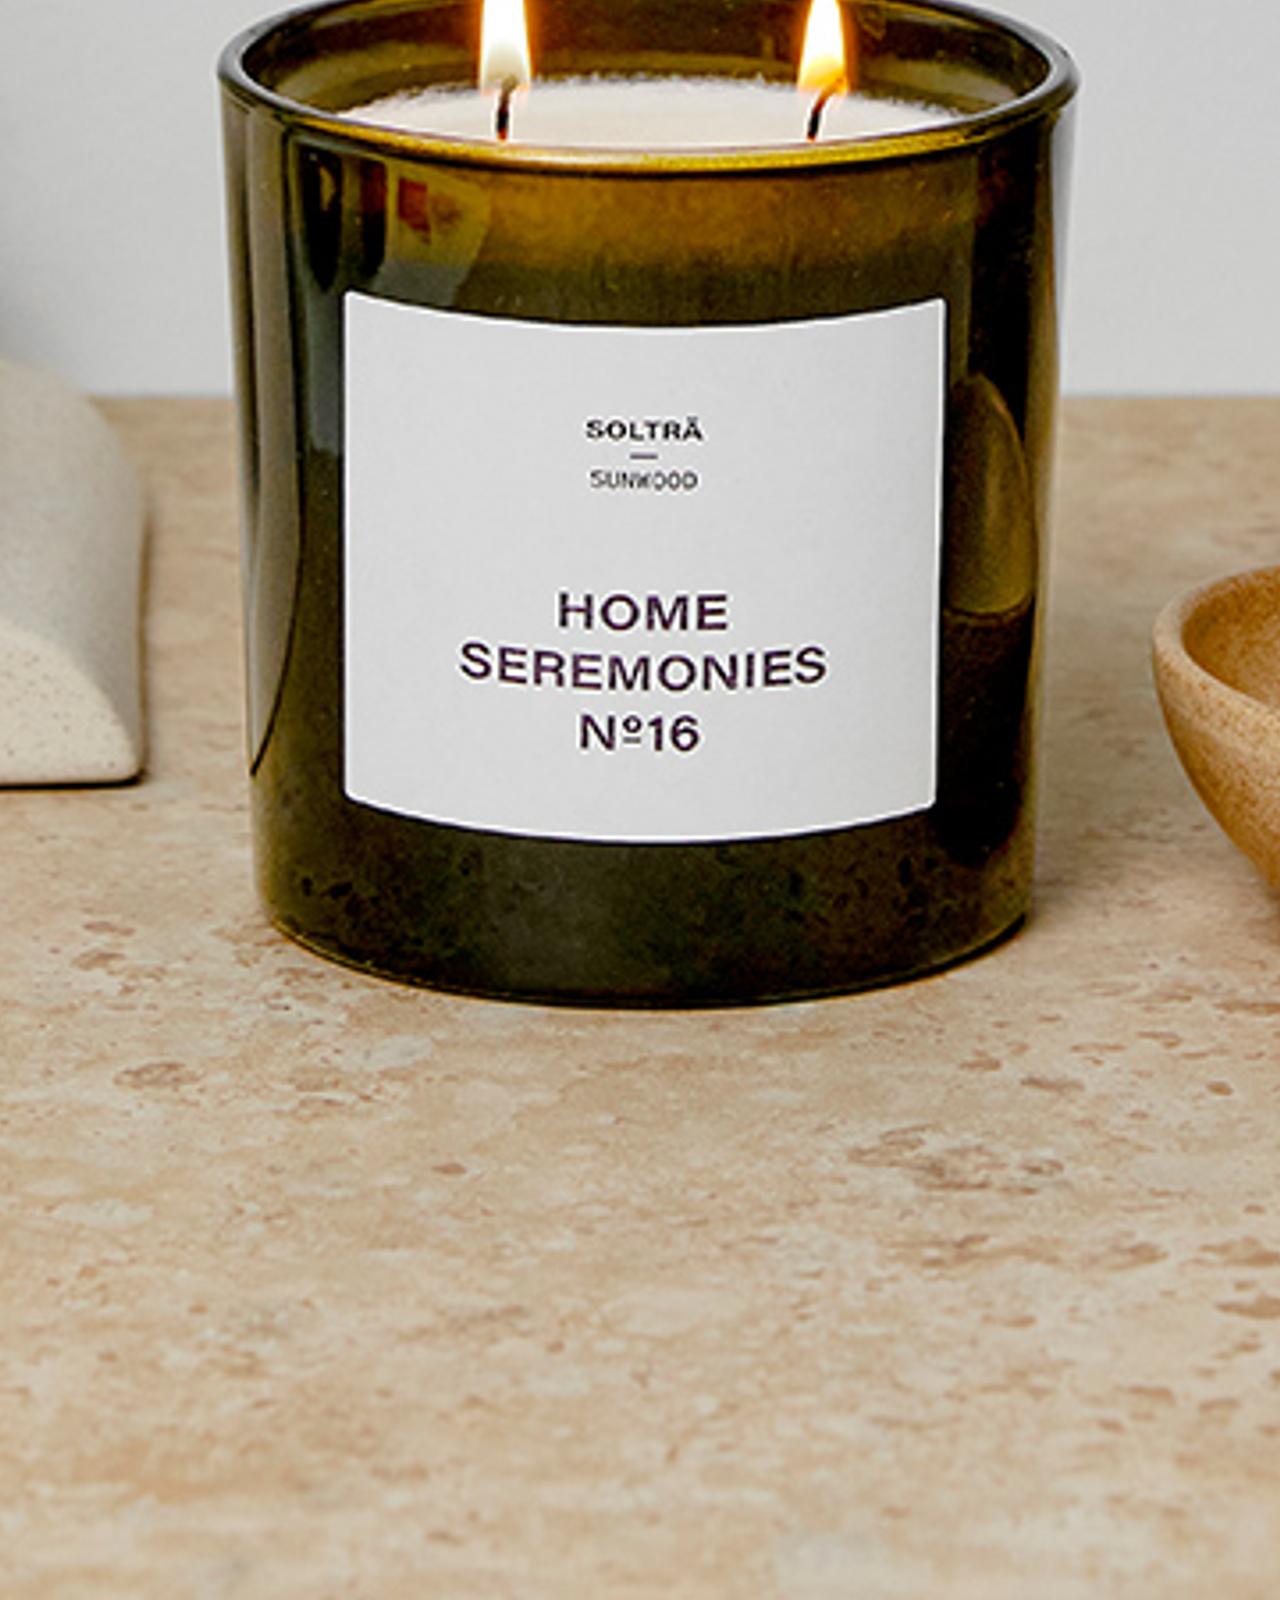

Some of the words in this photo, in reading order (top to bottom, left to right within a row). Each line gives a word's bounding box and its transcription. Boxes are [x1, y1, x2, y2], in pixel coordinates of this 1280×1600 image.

[589, 469, 699, 491] SUNWOOD
[558, 592, 728, 631] HOME
[460, 641, 827, 692] SEREMONIES
